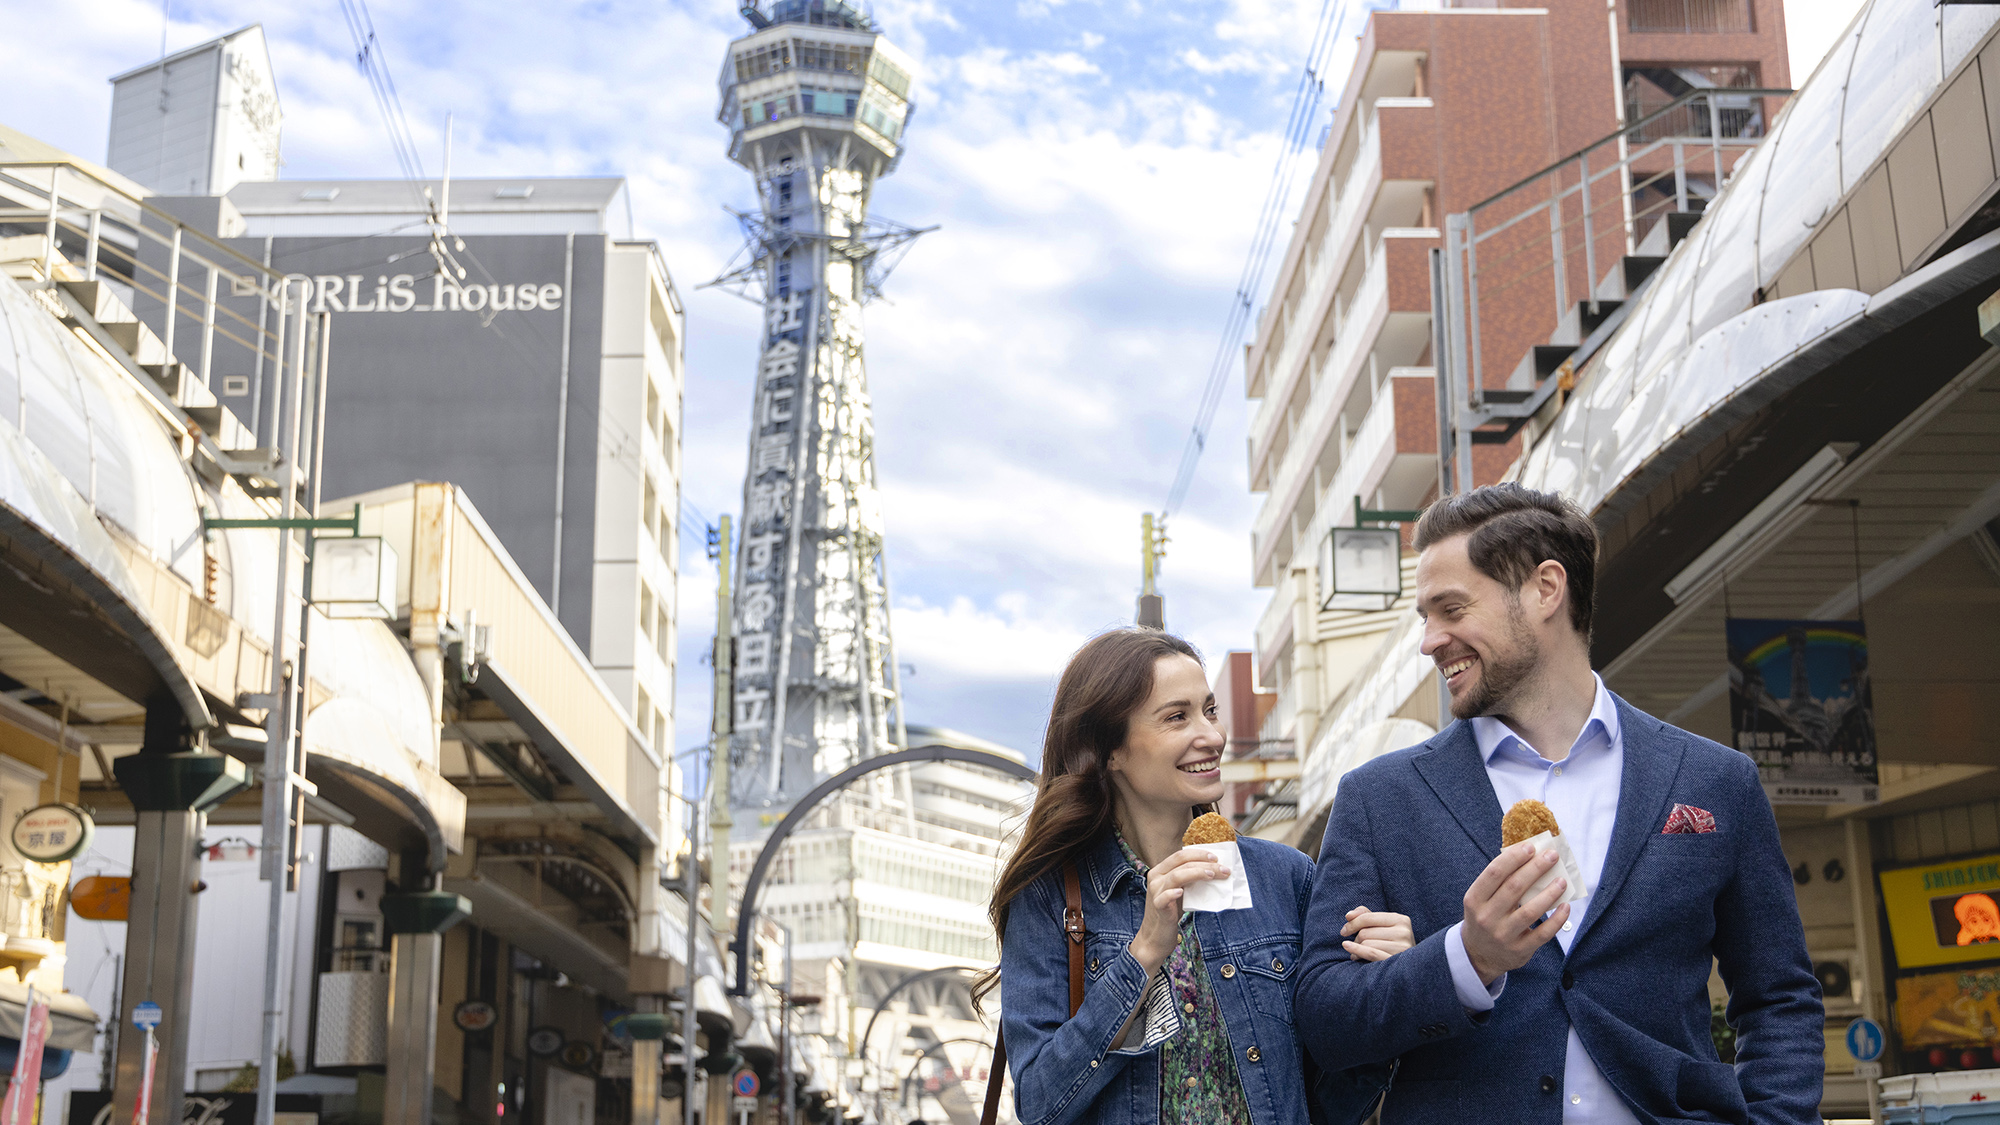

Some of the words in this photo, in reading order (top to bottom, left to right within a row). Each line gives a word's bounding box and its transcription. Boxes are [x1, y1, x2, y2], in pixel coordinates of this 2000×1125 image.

[734, 292, 804, 731] 社会に貢献する日立
